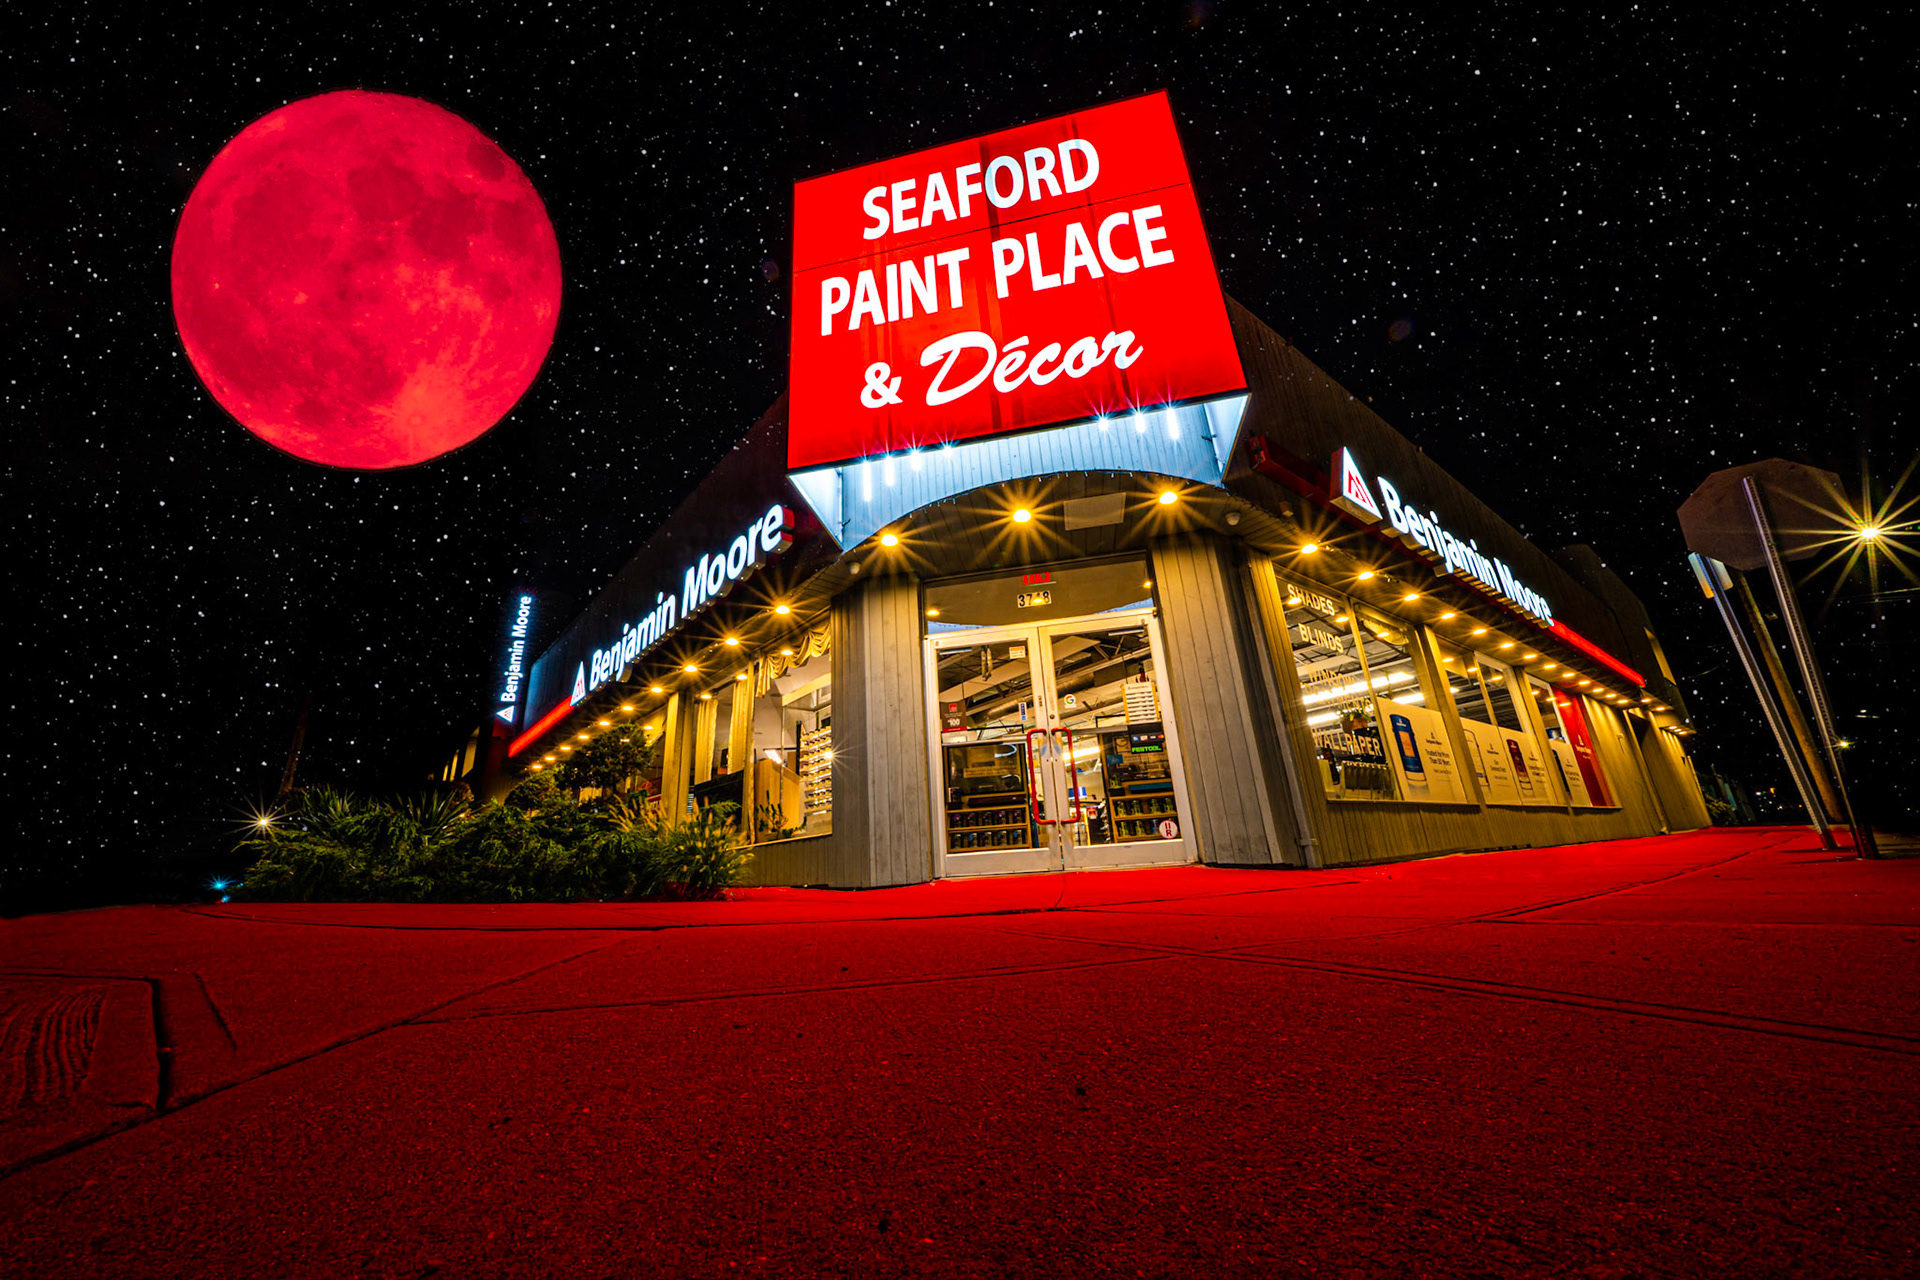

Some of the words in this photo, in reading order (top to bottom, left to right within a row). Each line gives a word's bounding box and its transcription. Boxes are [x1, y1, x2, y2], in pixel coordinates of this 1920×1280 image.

[861, 138, 1100, 240] SEAFORD
[820, 247, 970, 337] PAINT
[991, 205, 1175, 299] PLACE
[860, 361, 903, 409] &
[920, 330, 1144, 407] Décor
[1377, 475, 1502, 594] Benjamin
[1493, 556, 1555, 627] Moore
[511, 595, 532, 638] Moore
[588, 591, 676, 692] Benjamin
[680, 504, 785, 619] Moore
[1018, 590, 1050, 607] 378
[1287, 583, 1335, 616] SHADES
[1298, 623, 1344, 654] BLINDS
[500, 639, 525, 702] Benjamin
[1131, 745, 1162, 754] FESTOOL
[1311, 727, 1382, 757] WALLPAPER
